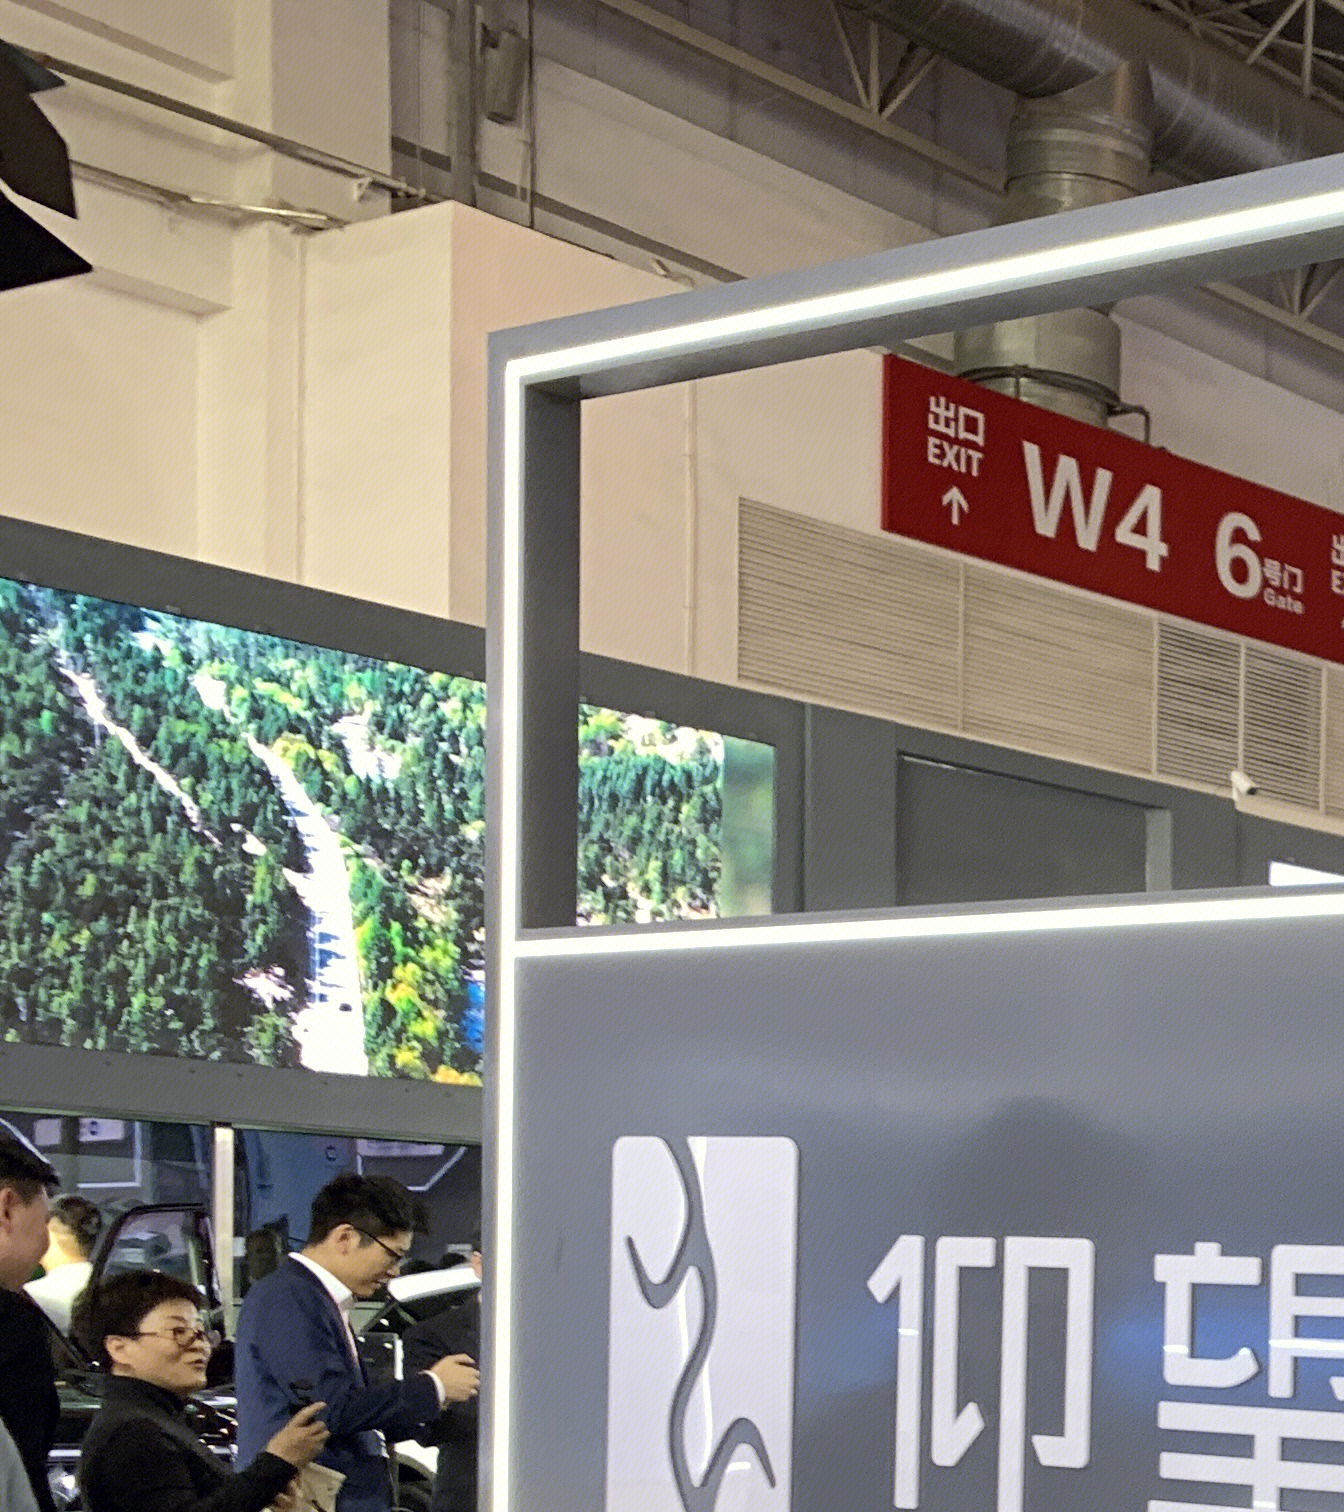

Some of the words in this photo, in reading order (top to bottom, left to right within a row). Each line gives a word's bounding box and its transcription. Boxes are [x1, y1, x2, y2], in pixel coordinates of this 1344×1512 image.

[927, 395, 985, 447] 出口
[927, 436, 984, 477] EXIT
[1022, 440, 1168, 573] W4
[1215, 511, 1263, 599] 6
[1263, 557, 1304, 594] 号门
[1263, 587, 1305, 615] Gate
